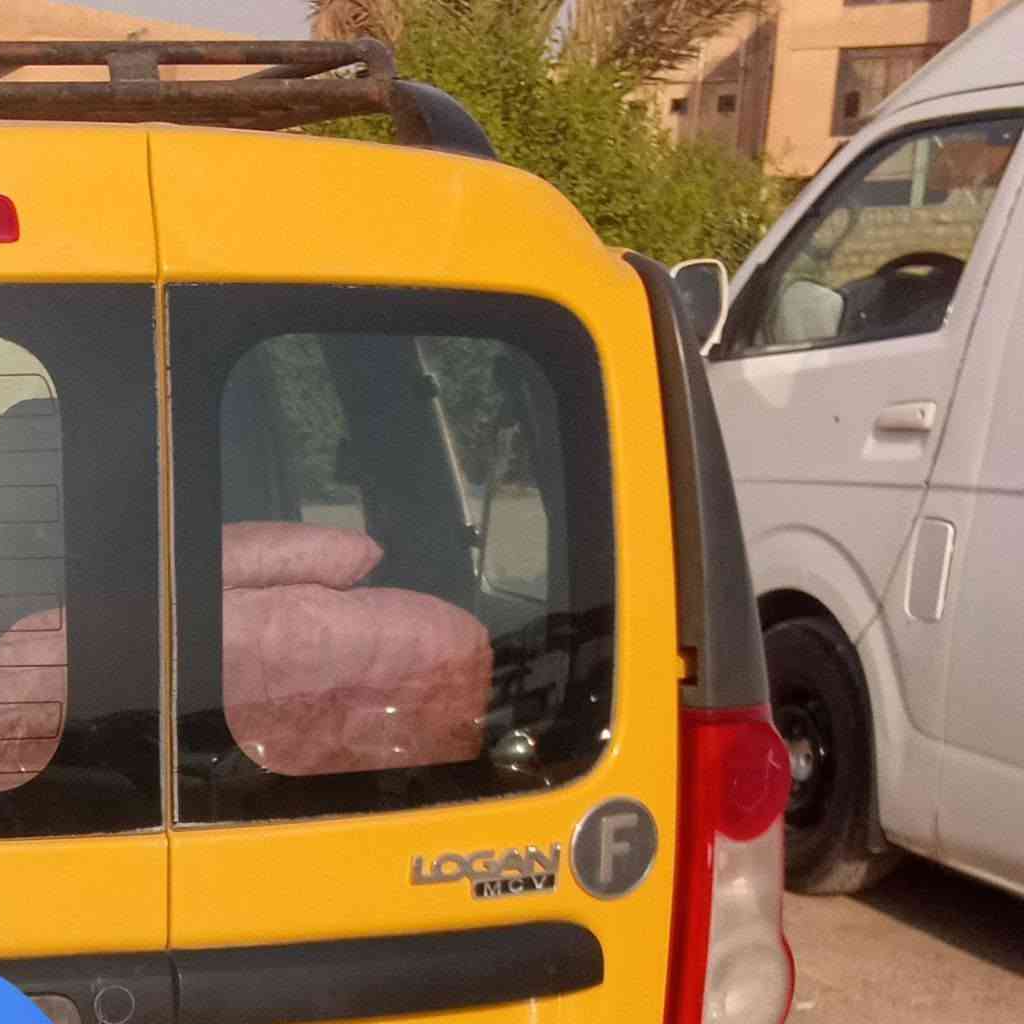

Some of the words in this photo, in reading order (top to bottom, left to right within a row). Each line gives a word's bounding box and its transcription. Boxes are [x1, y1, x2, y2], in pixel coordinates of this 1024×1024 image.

[411, 843, 560, 885] LOGAN
[599, 814, 638, 883] F
[481, 877, 551, 897] MCV
